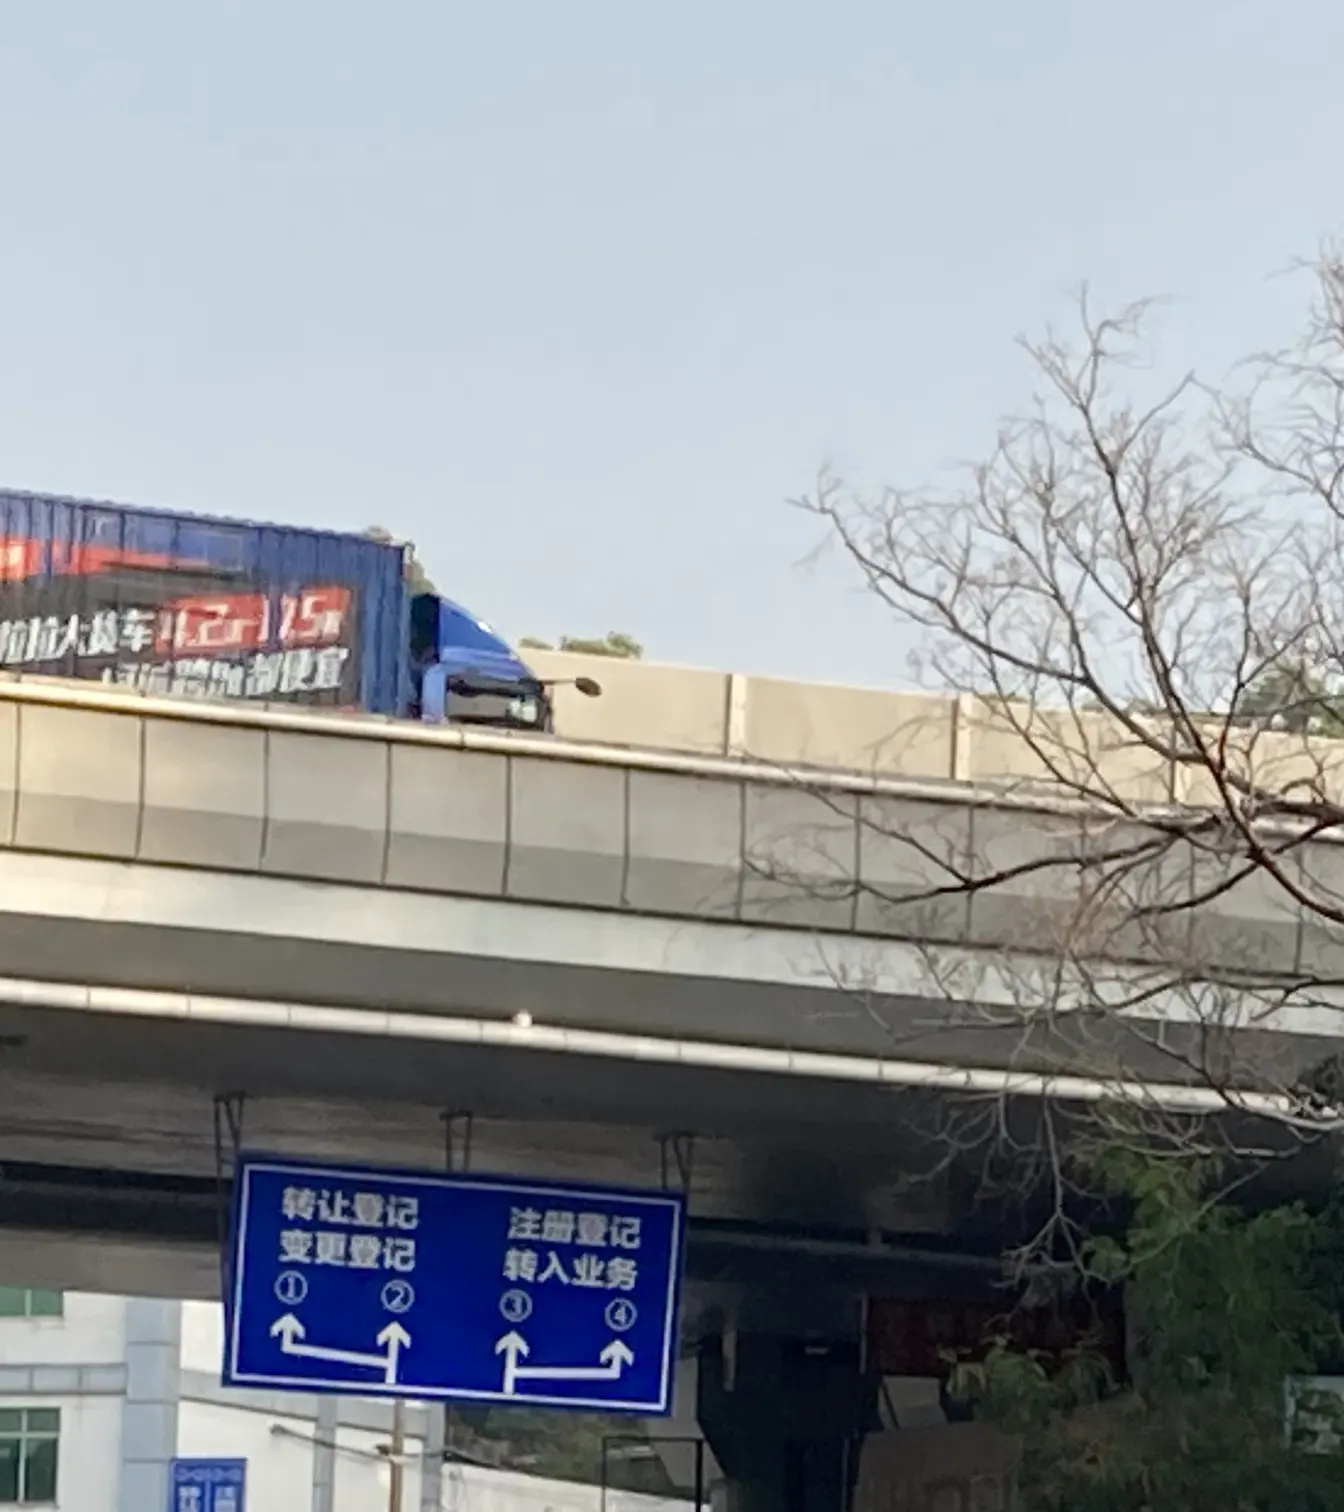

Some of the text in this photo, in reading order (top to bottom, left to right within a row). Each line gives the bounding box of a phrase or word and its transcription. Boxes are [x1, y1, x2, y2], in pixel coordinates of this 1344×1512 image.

[282, 1184, 420, 1231] 转让登记
[507, 1206, 642, 1249] 注册登记
[278, 1229, 417, 1273] 变更登记
[502, 1248, 639, 1292] 转入业务
